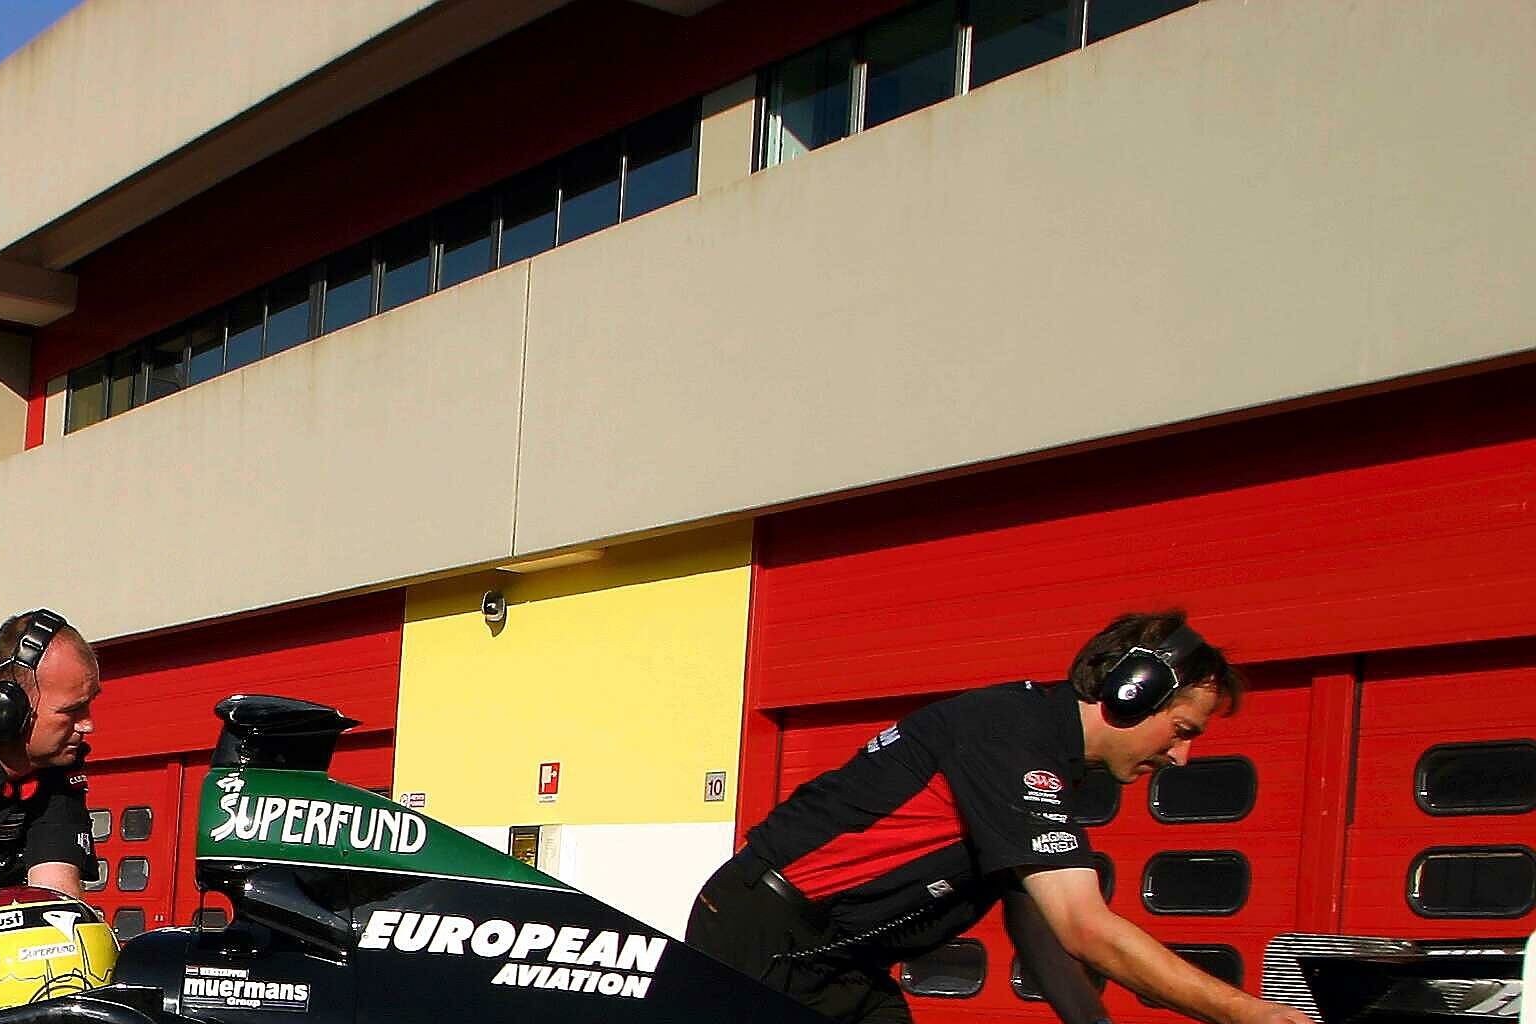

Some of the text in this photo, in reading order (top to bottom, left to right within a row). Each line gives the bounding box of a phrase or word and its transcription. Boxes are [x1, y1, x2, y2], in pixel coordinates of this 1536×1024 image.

[707, 778, 722, 796] 10
[211, 792, 426, 853] SUPERFUND
[358, 910, 667, 973] EUROPEAN
[184, 978, 308, 1001] muermans
[491, 963, 652, 998] AVIATION
